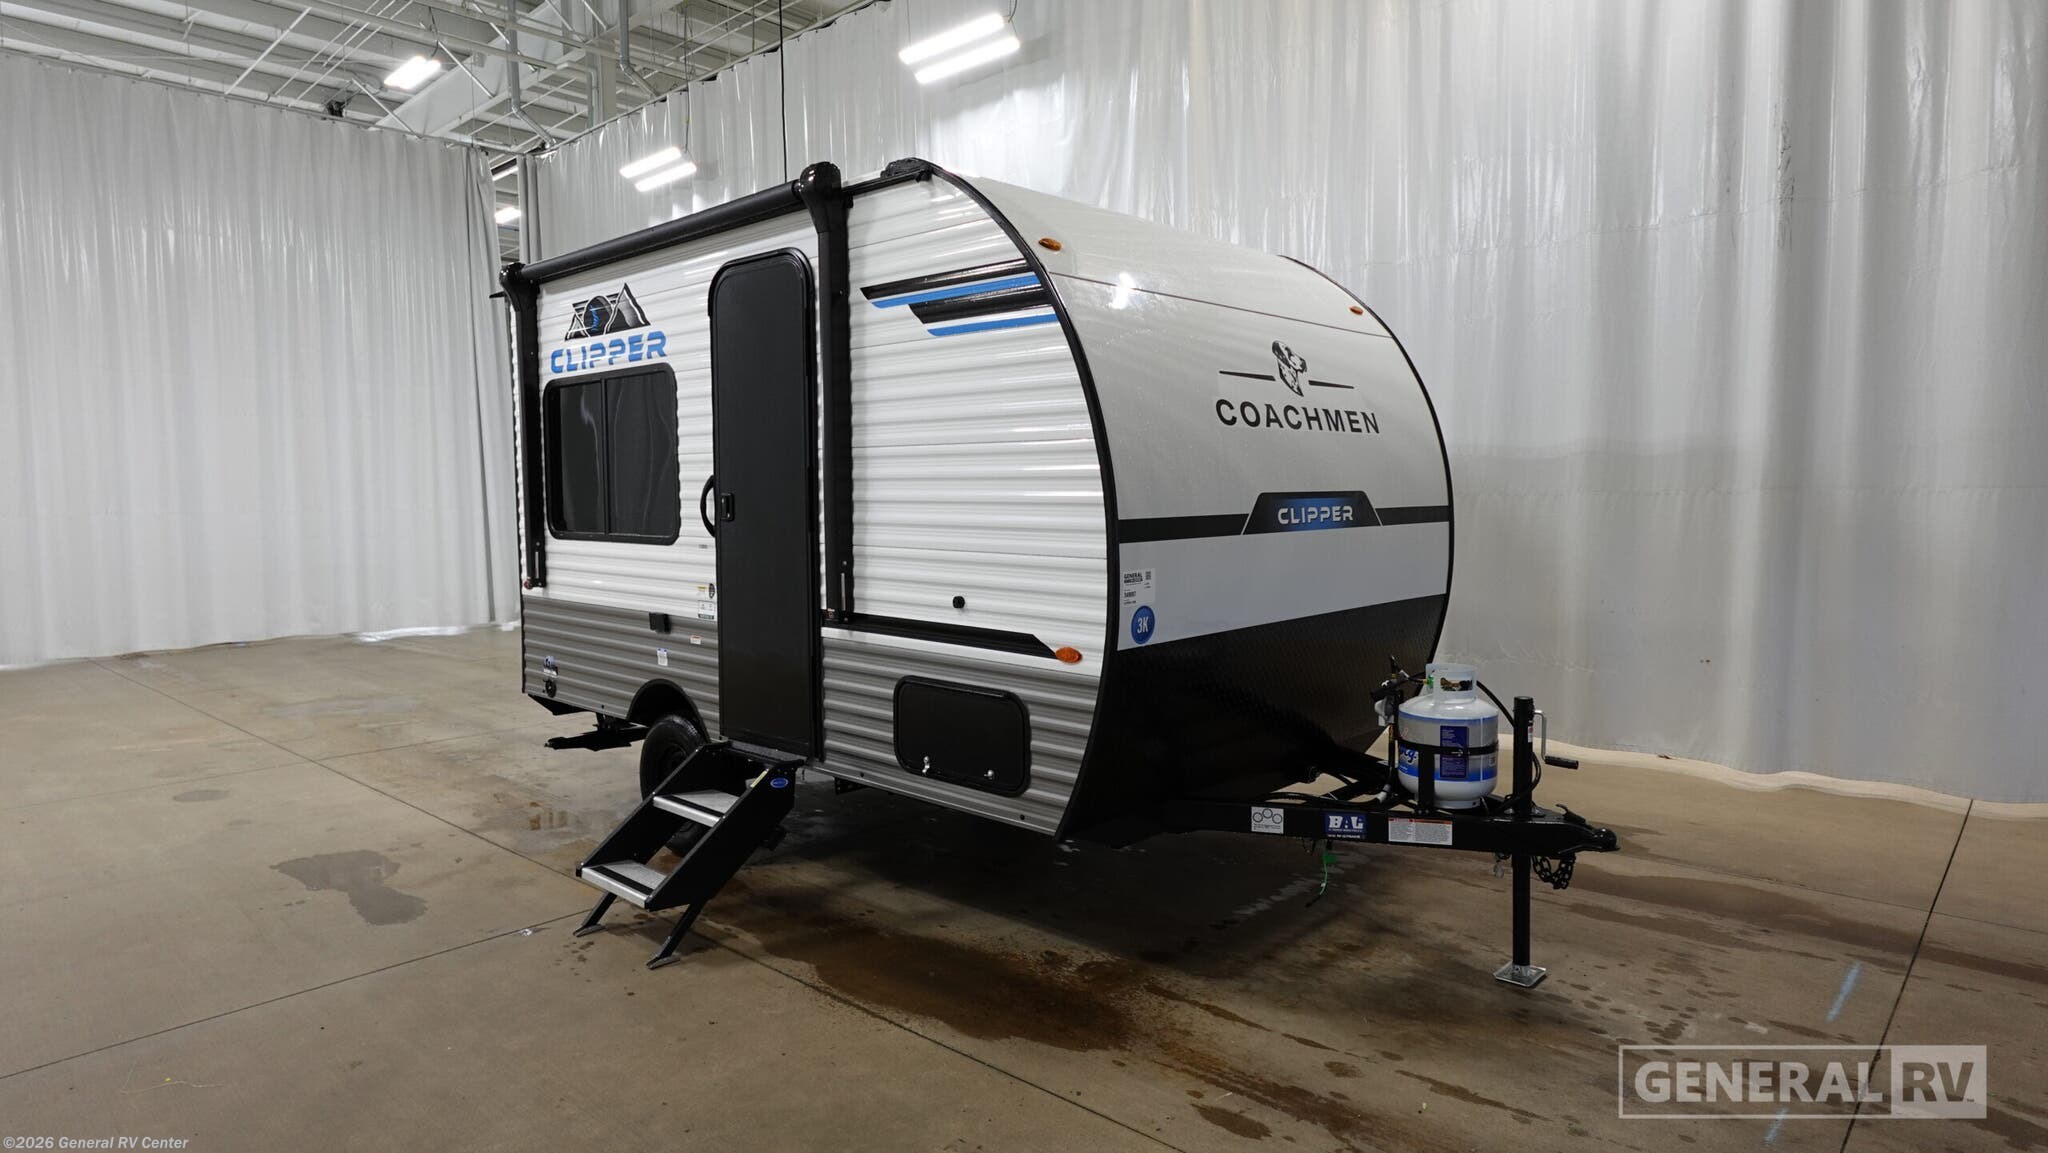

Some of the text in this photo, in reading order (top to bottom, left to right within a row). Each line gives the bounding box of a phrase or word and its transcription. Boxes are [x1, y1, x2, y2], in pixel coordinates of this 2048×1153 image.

[550, 331, 667, 374] CLIPPER
[1215, 399, 1380, 434] COACHMEN
[1277, 505, 1354, 525] CLIPPER
[1136, 615, 1149, 634] 3K
[1328, 815, 1364, 829] BAL
